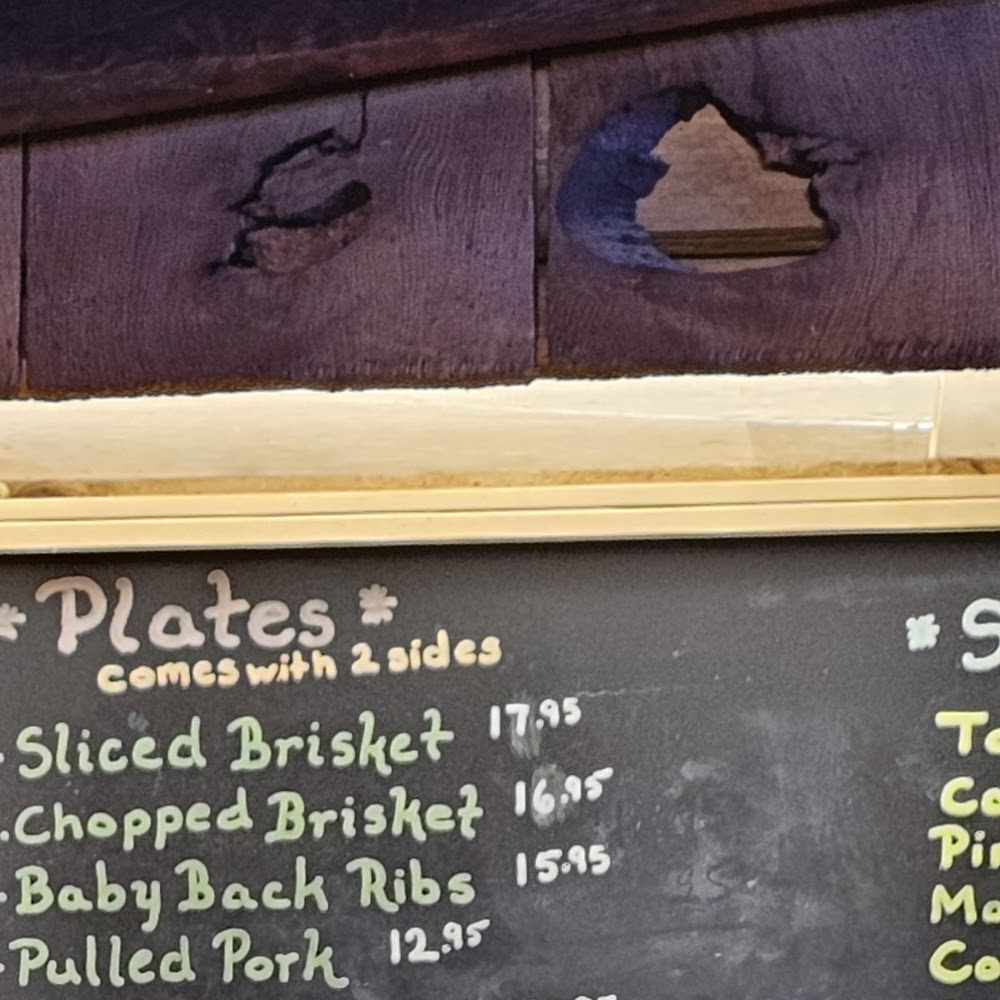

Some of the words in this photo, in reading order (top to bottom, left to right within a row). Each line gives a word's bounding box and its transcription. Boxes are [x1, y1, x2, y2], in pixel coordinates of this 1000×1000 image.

[35, 570, 336, 655] Plates
[98, 656, 240, 694] comes
[246, 652, 337, 685] with
[351, 643, 380, 674] 2
[388, 630, 502, 672] sides
[16, 716, 206, 779] Sliced
[227, 711, 455, 777] Brisket
[489, 697, 582, 739] 17.95
[14, 787, 254, 850] Chopped
[264, 786, 484, 844] Brisket
[514, 768, 613, 815] 16.95
[15, 859, 162, 932] Baby
[175, 856, 329, 911] Back
[346, 856, 476, 912] Ribs
[515, 844, 612, 887] 15.95
[9, 936, 196, 987] Pulled
[212, 928, 349, 988] Pork
[390, 919, 491, 964] 12.95
